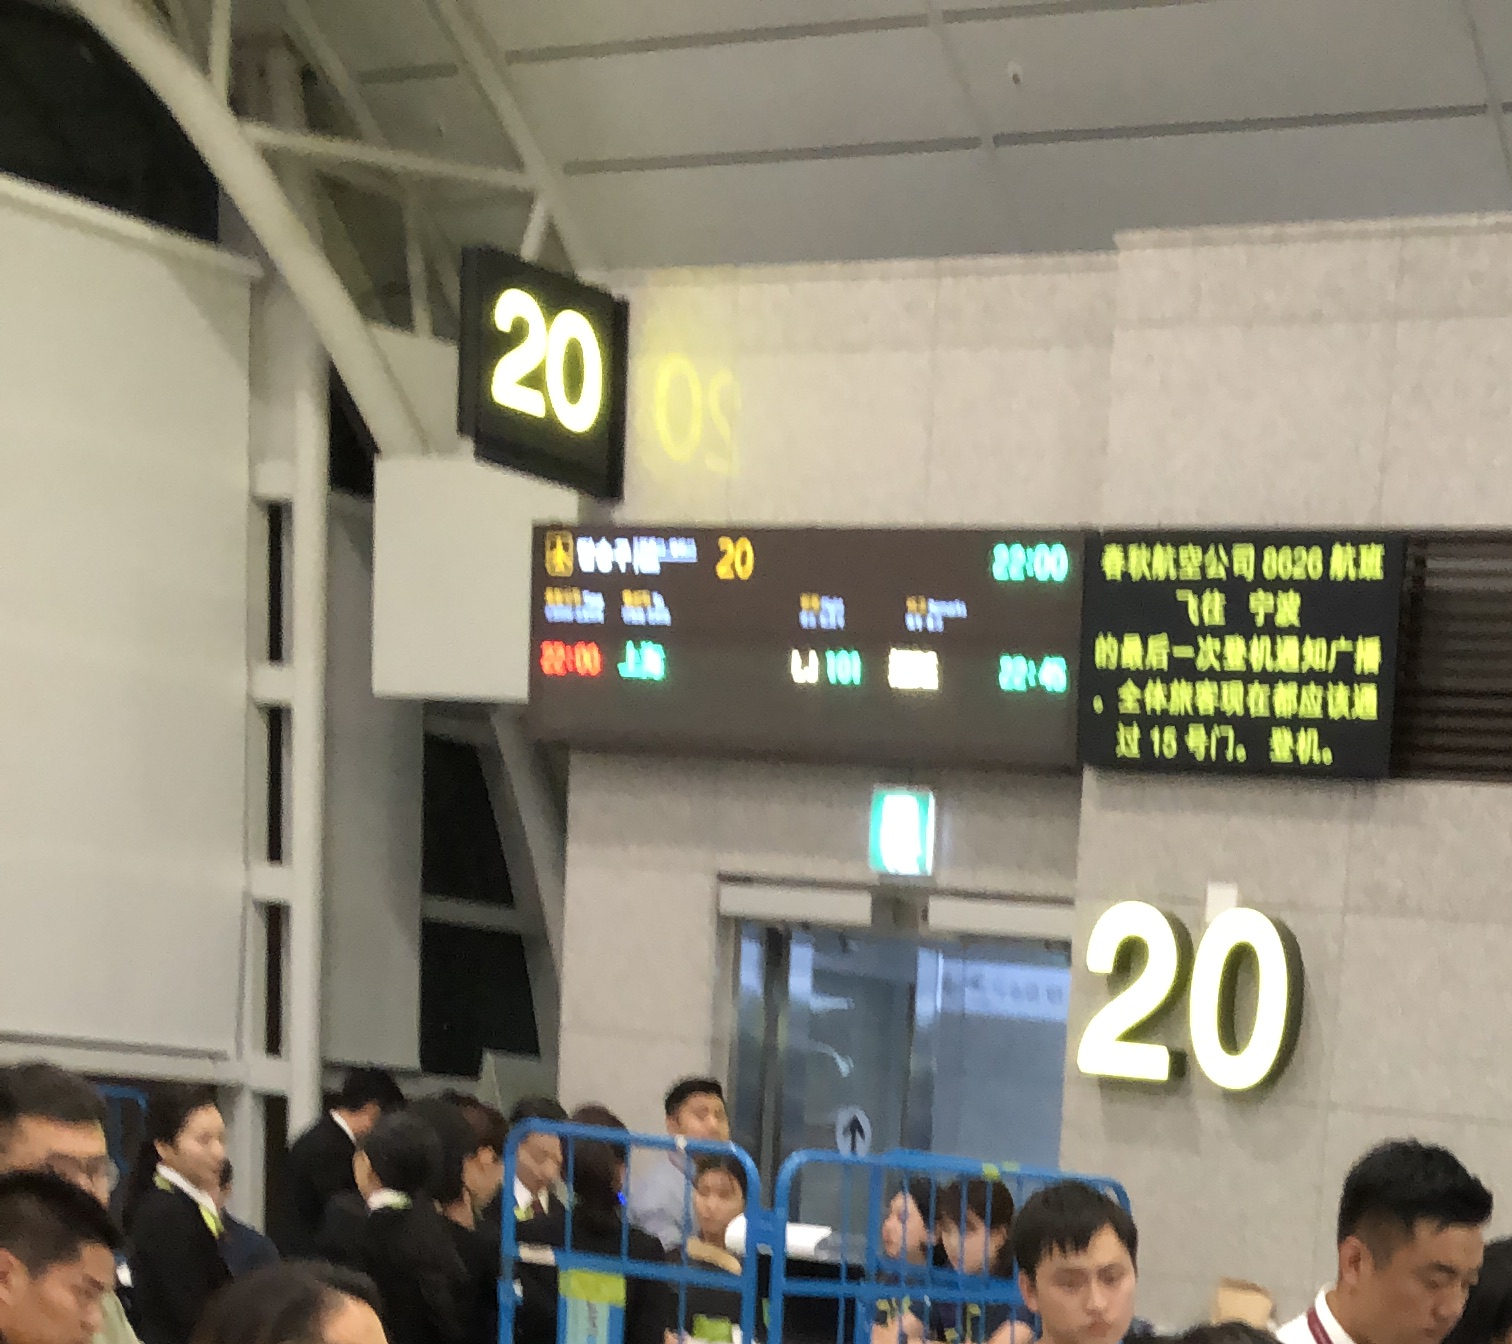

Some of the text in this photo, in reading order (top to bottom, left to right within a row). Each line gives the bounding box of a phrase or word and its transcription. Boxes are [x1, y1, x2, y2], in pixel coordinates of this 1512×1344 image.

[491, 288, 603, 433] 20
[715, 535, 755, 581] 20
[1077, 900, 1292, 1090] 20
